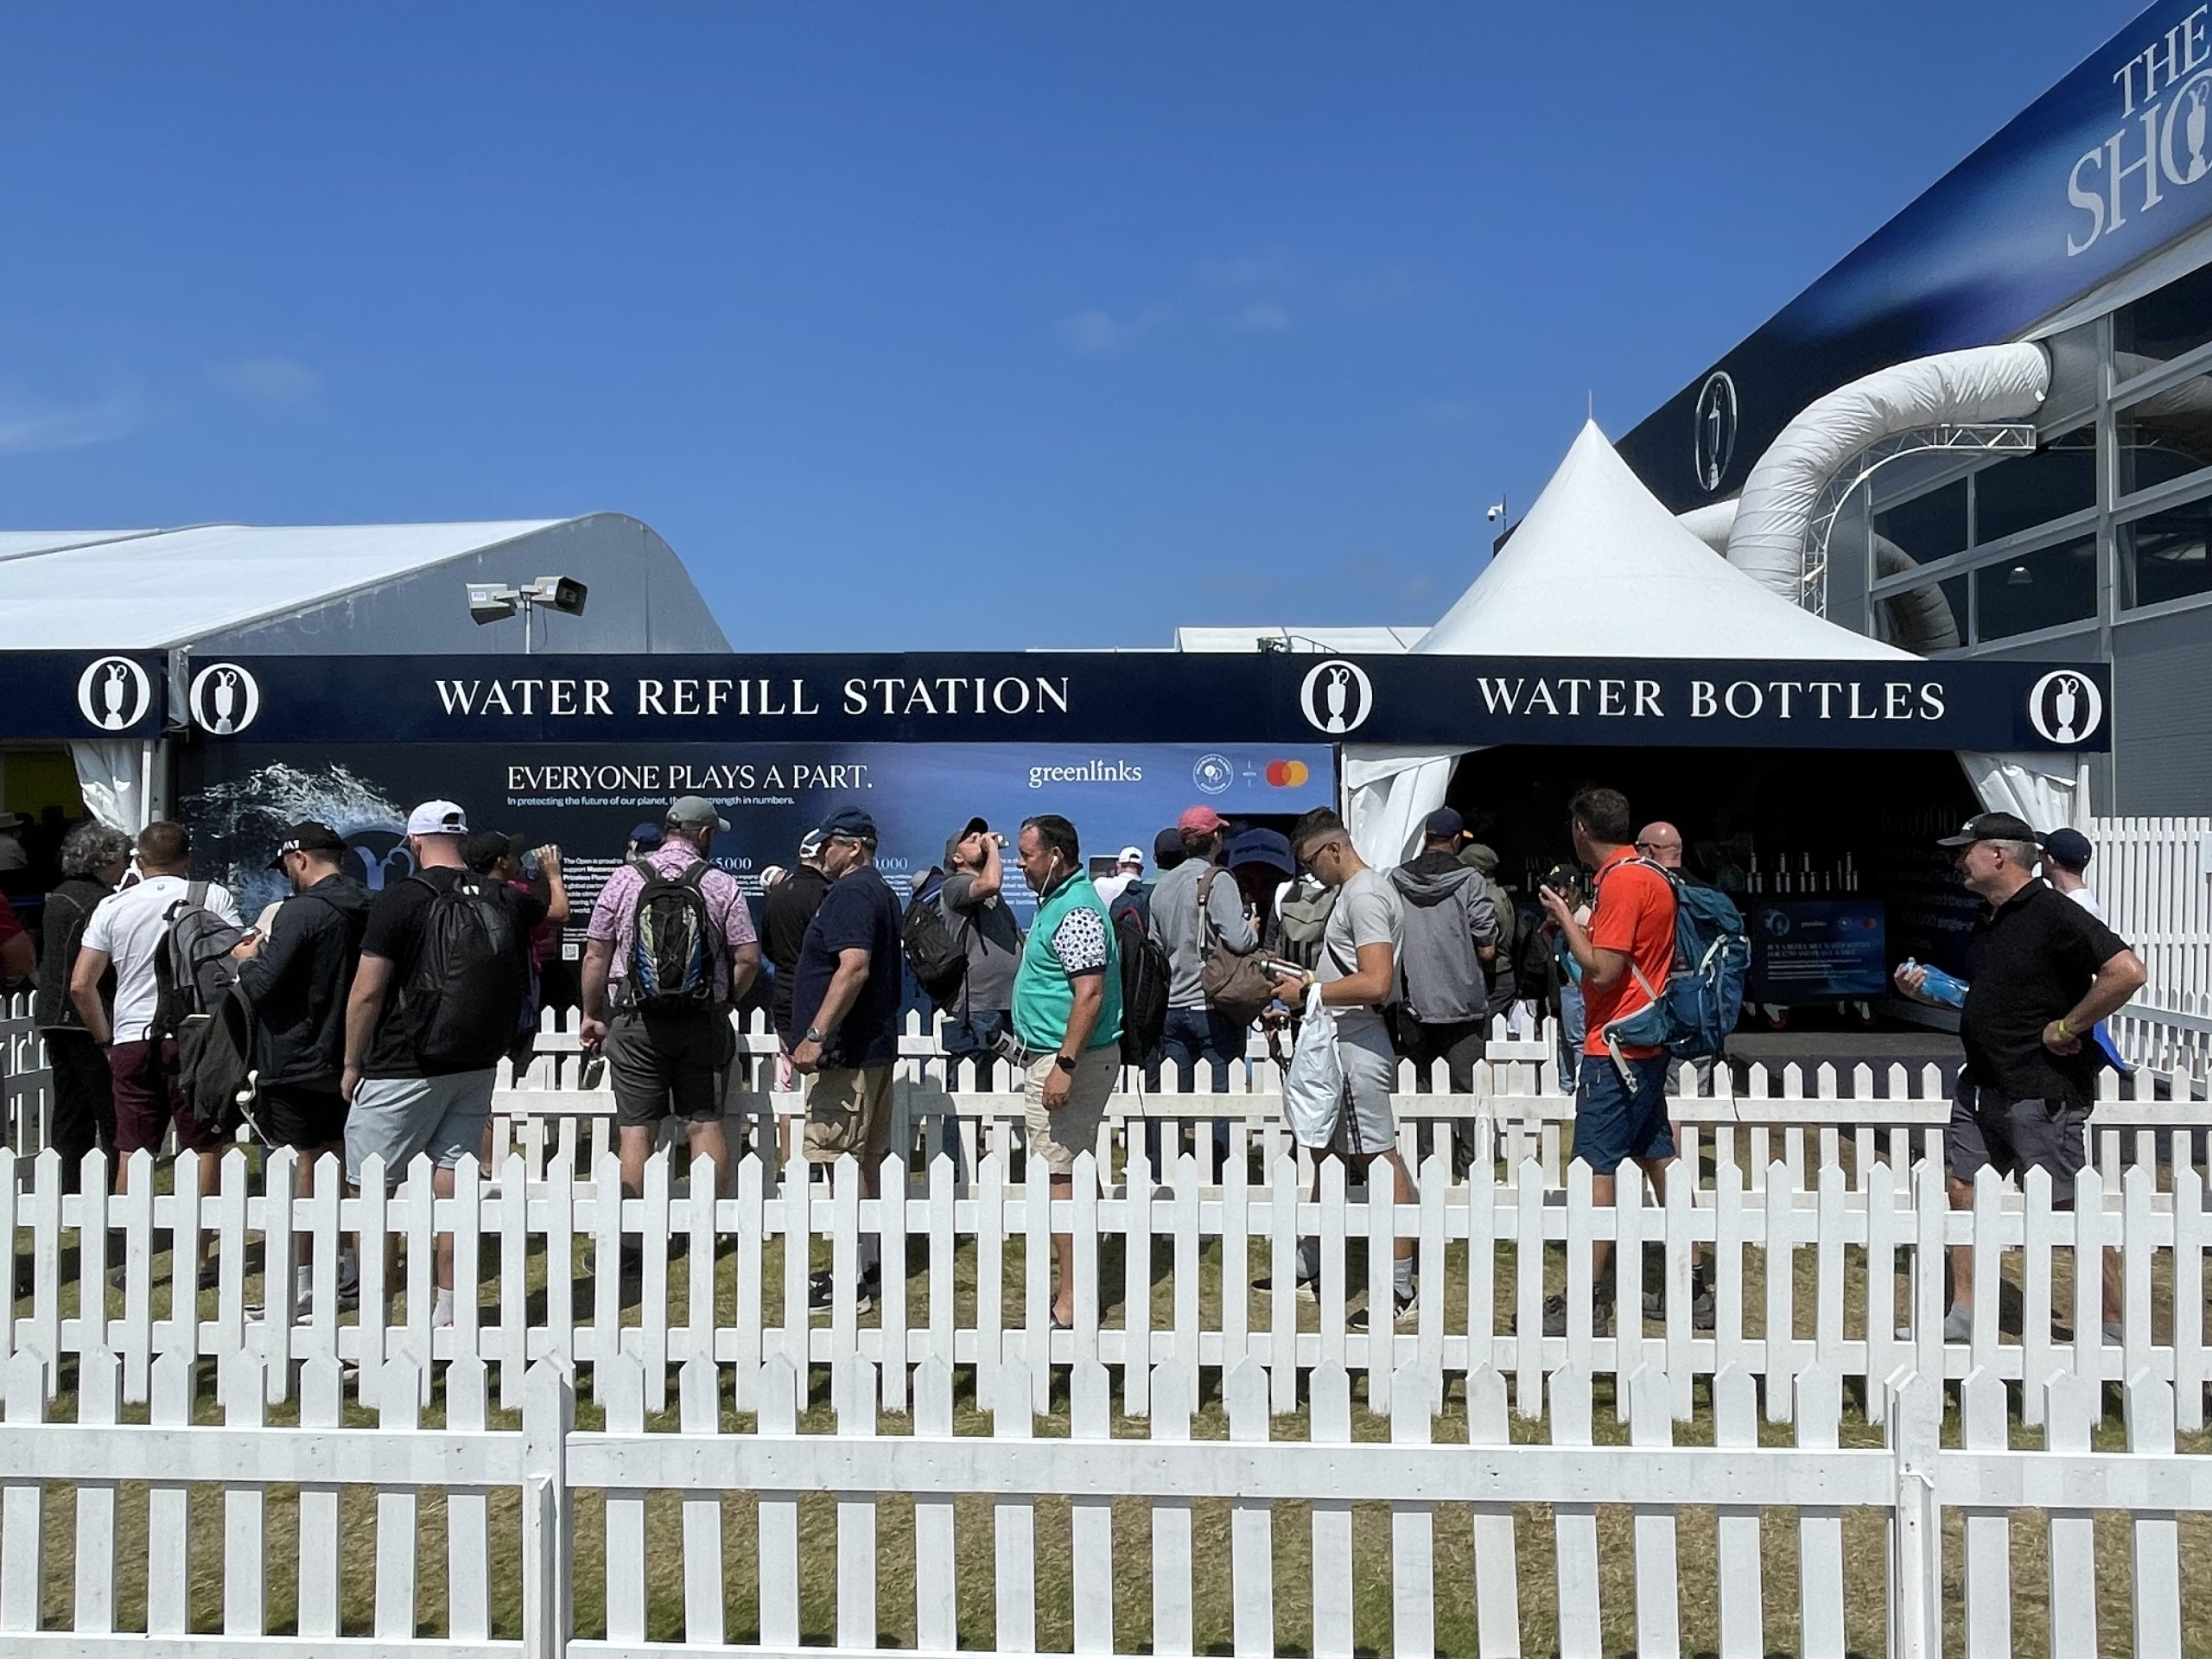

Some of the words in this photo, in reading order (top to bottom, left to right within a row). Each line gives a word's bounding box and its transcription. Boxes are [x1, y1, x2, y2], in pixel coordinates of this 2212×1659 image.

[2113, 3, 2210, 119] THE
[435, 679, 613, 715] WATER
[637, 679, 819, 715] REFILL
[843, 677, 1071, 715] STATION
[1477, 677, 1664, 717] WATER
[1690, 681, 1945, 720] BOTTLES
[508, 766, 660, 790] EVERYONE
[669, 765, 755, 789] PLAYS
[763, 765, 785, 789] A
[793, 765, 873, 789] PART.
[1028, 759, 1142, 789] greenlinks
[507, 796, 516, 805] In
[518, 796, 564, 807] protecting
[565, 796, 580, 805] the
[582, 796, 608, 805] future
[610, 796, 620, 805] of
[743, 796, 752, 805] in
